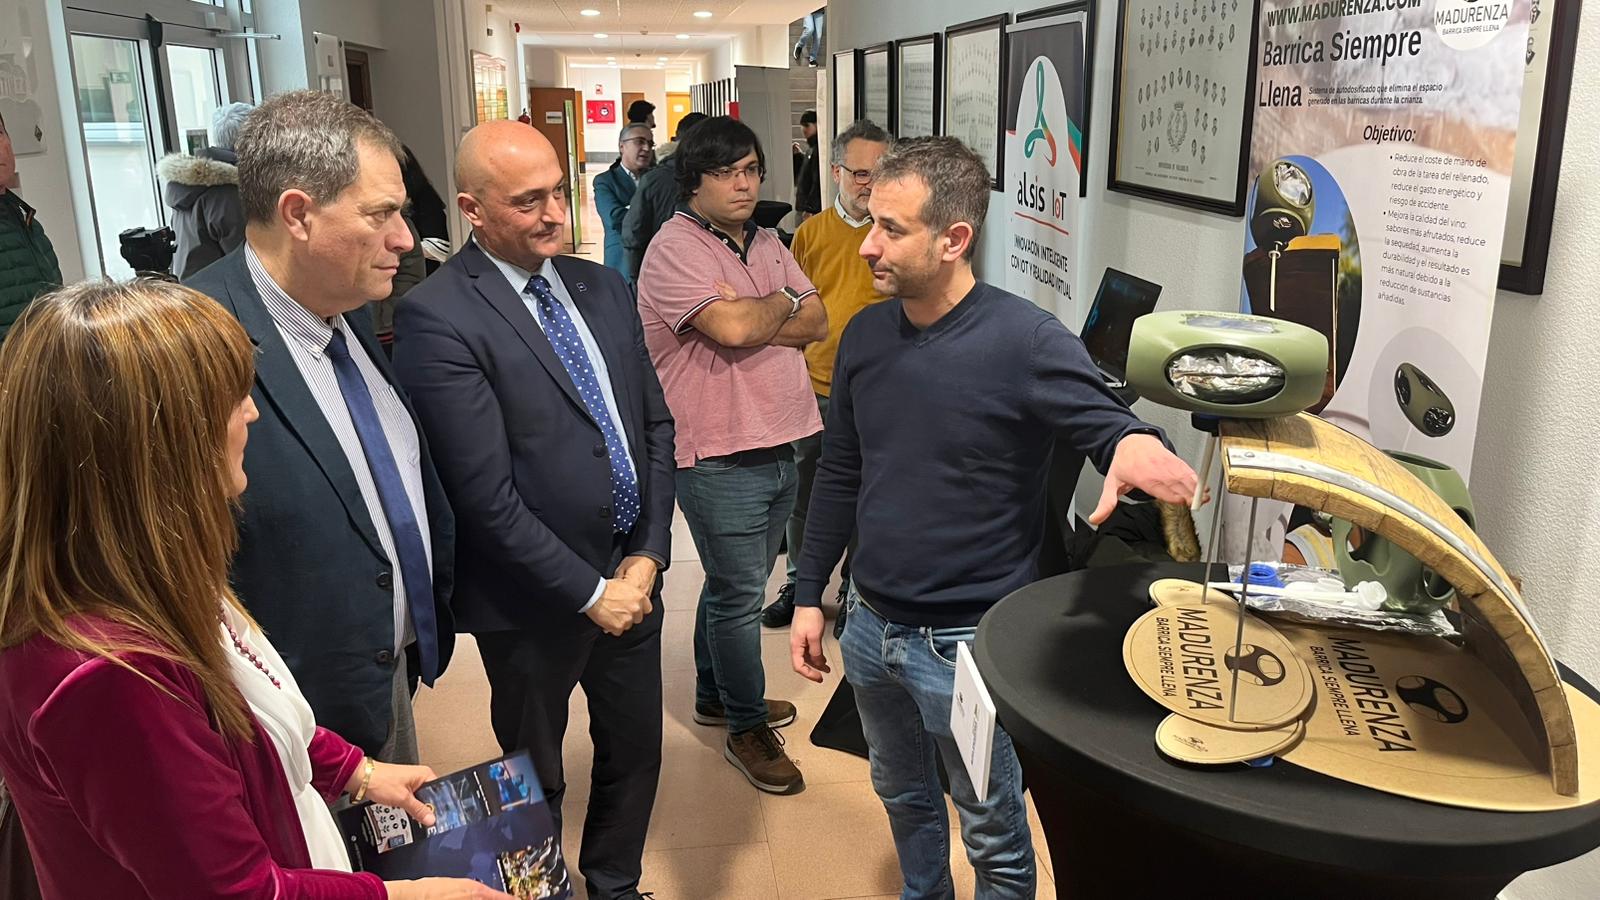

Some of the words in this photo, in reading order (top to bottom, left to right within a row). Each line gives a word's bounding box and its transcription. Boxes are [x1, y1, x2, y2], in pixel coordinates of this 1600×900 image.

[1435, 4, 1508, 26] MADURENZA
[1463, 26, 1482, 34] SIEMPRE
[1483, 24, 1500, 32] LLENA
[1262, 36, 1324, 66] Barrica
[1329, 30, 1422, 66] Siempre
[1259, 80, 1302, 107] Llena
[1309, 86, 1328, 95] Sistema
[1328, 87, 1335, 95] de
[1336, 84, 1376, 94] autodosificado
[1377, 85, 1388, 95] que
[1388, 84, 1412, 93] elimina
[1412, 83, 1418, 92] el
[1419, 83, 1443, 93] espacio
[1347, 96, 1370, 105] barricas
[1370, 95, 1393, 105] durante
[1393, 95, 1399, 104] la
[1363, 124, 1417, 145] Objetivo:
[1394, 153, 1418, 163] Reduce
[1418, 155, 1424, 163] el
[1424, 156, 1442, 165] coste
[1443, 157, 1452, 165] de
[1453, 159, 1474, 167] mano
[1475, 158, 1487, 168] de
[1392, 168, 1407, 177] obra
[1408, 169, 1416, 177] de
[1417, 170, 1422, 178] la
[1423, 171, 1439, 180] tarea
[1440, 172, 1451, 181] del
[1453, 173, 1490, 185] rellenado,
[1390, 196, 1409, 207] riesgo
[1409, 198, 1417, 206] de
[1391, 182, 1412, 192] reduce
[1413, 184, 1419, 192] el
[1420, 186, 1437, 195] gasto
[1438, 187, 1476, 199] energético
[1477, 192, 1483, 201] y
[1052, 188, 1067, 220] IoT
[1388, 210, 1409, 220] Mejora
[1410, 213, 1415, 221] la
[1415, 214, 1437, 225] calidad
[1438, 217, 1450, 226] del
[1386, 224, 1409, 235] sabores
[1457, 236, 1486, 247] reduce
[1384, 237, 1390, 246] la
[1421, 245, 1451, 257] aumenta
[1452, 249, 1459, 258] la
[1382, 251, 1415, 265] durabilidad
[1416, 259, 1420, 267] y
[1421, 259, 1427, 267] el
[1428, 261, 1459, 274] resultado
[1461, 267, 1470, 276] es
[1011, 254, 1020, 269] CON
[1020, 259, 1029, 273] IOT
[1033, 264, 1055, 288] REALIDAD
[1055, 277, 1072, 300] VIRTUAL
[1395, 268, 1415, 279] natural
[1416, 272, 1438, 284] debido
[1439, 278, 1443, 286] a
[1444, 278, 1451, 287] la
[1380, 279, 1408, 292] reducción
[1409, 286, 1417, 294] de
[1418, 288, 1451, 303] sustancias
[1156, 617, 1171, 645] BARRICA
[1158, 645, 1175, 675] SIEMPRE
[1176, 607, 1225, 709] MADURENZA
[1310, 645, 1334, 674] BARRICA
[1161, 675, 1177, 697] LLENA
[1322, 675, 1349, 709] SIEMPRE
[1327, 636, 1417, 752] MADURENZA
[1335, 706, 1361, 737] LLENA
